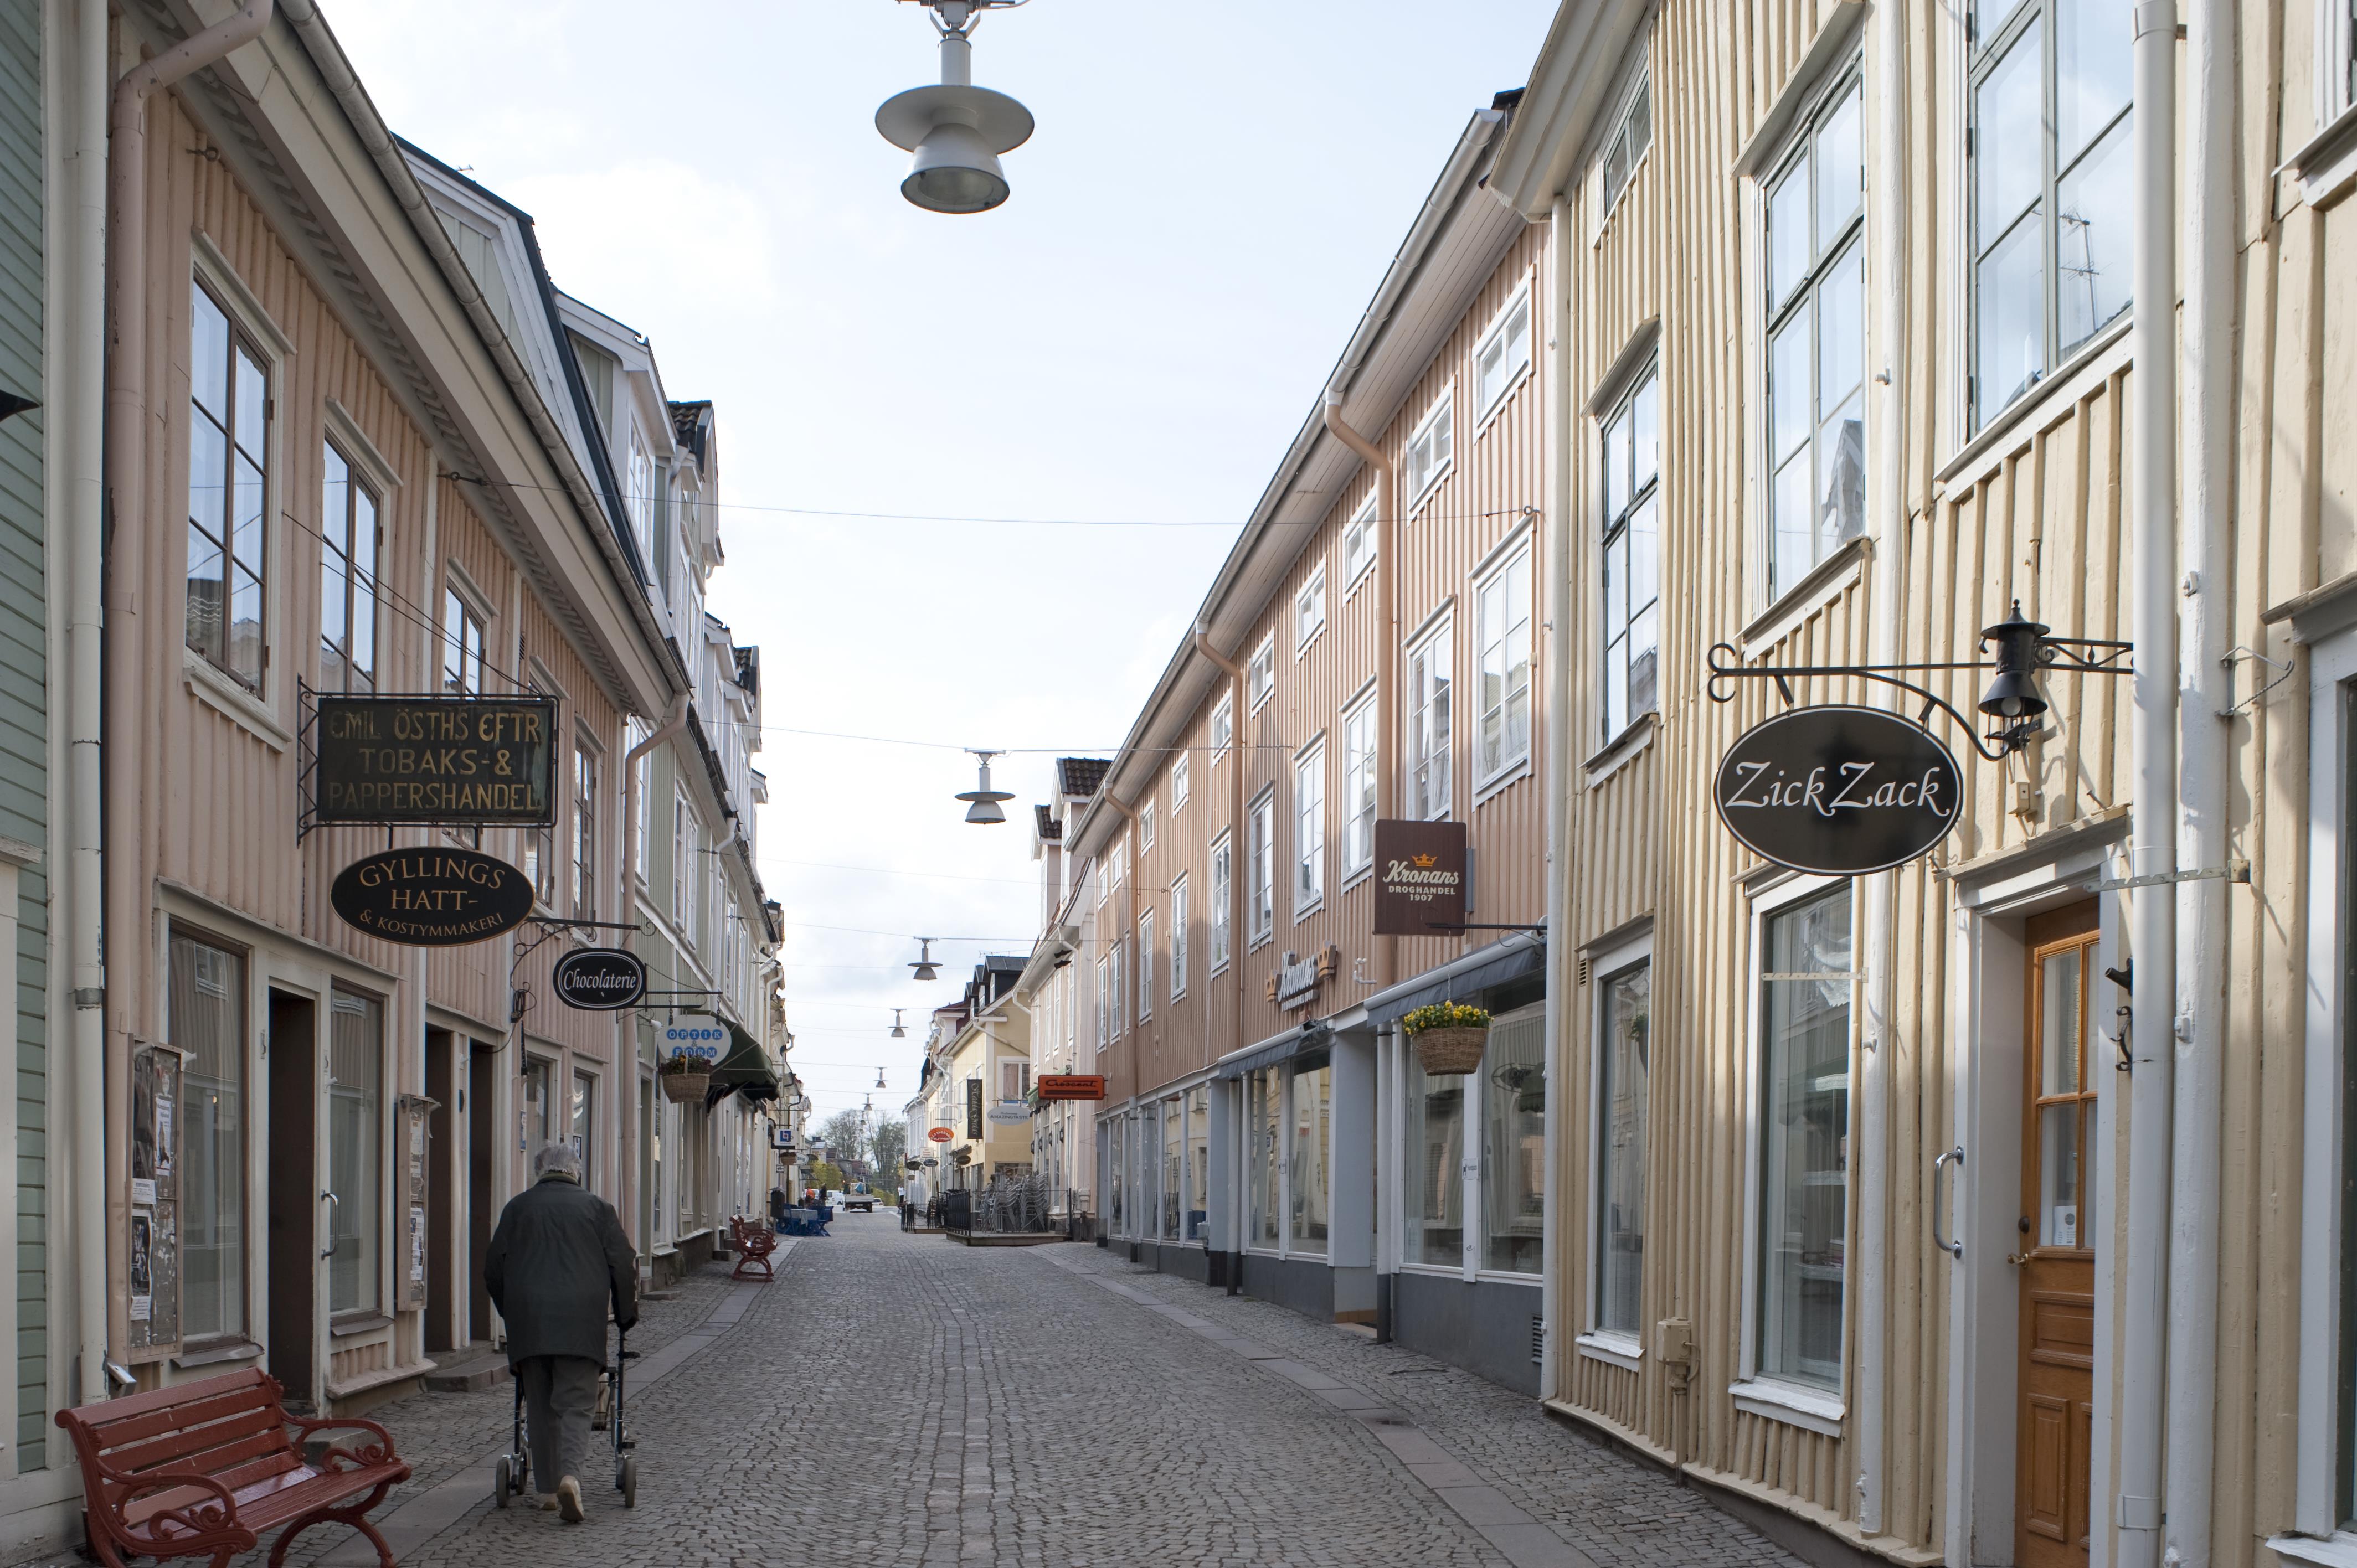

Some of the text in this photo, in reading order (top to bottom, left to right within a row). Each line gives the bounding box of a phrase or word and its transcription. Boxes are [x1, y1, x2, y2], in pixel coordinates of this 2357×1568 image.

[394, 708, 469, 742] ÖSTHS
[494, 750, 513, 776] &
[329, 782, 542, 811] PAPPERSHANDEL
[359, 857, 506, 889] GYLLINGS
[1382, 860, 1459, 884] Kronans
[390, 889, 478, 911] HATT-
[1388, 885, 1456, 895] DROGHANDEL
[359, 909, 504, 937] & KOSTYMMAKERI
[564, 968, 636, 991] Chocolaterie
[1278, 950, 1315, 1002] Kronans
[668, 1030, 722, 1039] OPTIK
[674, 1048, 717, 1057] FORM
